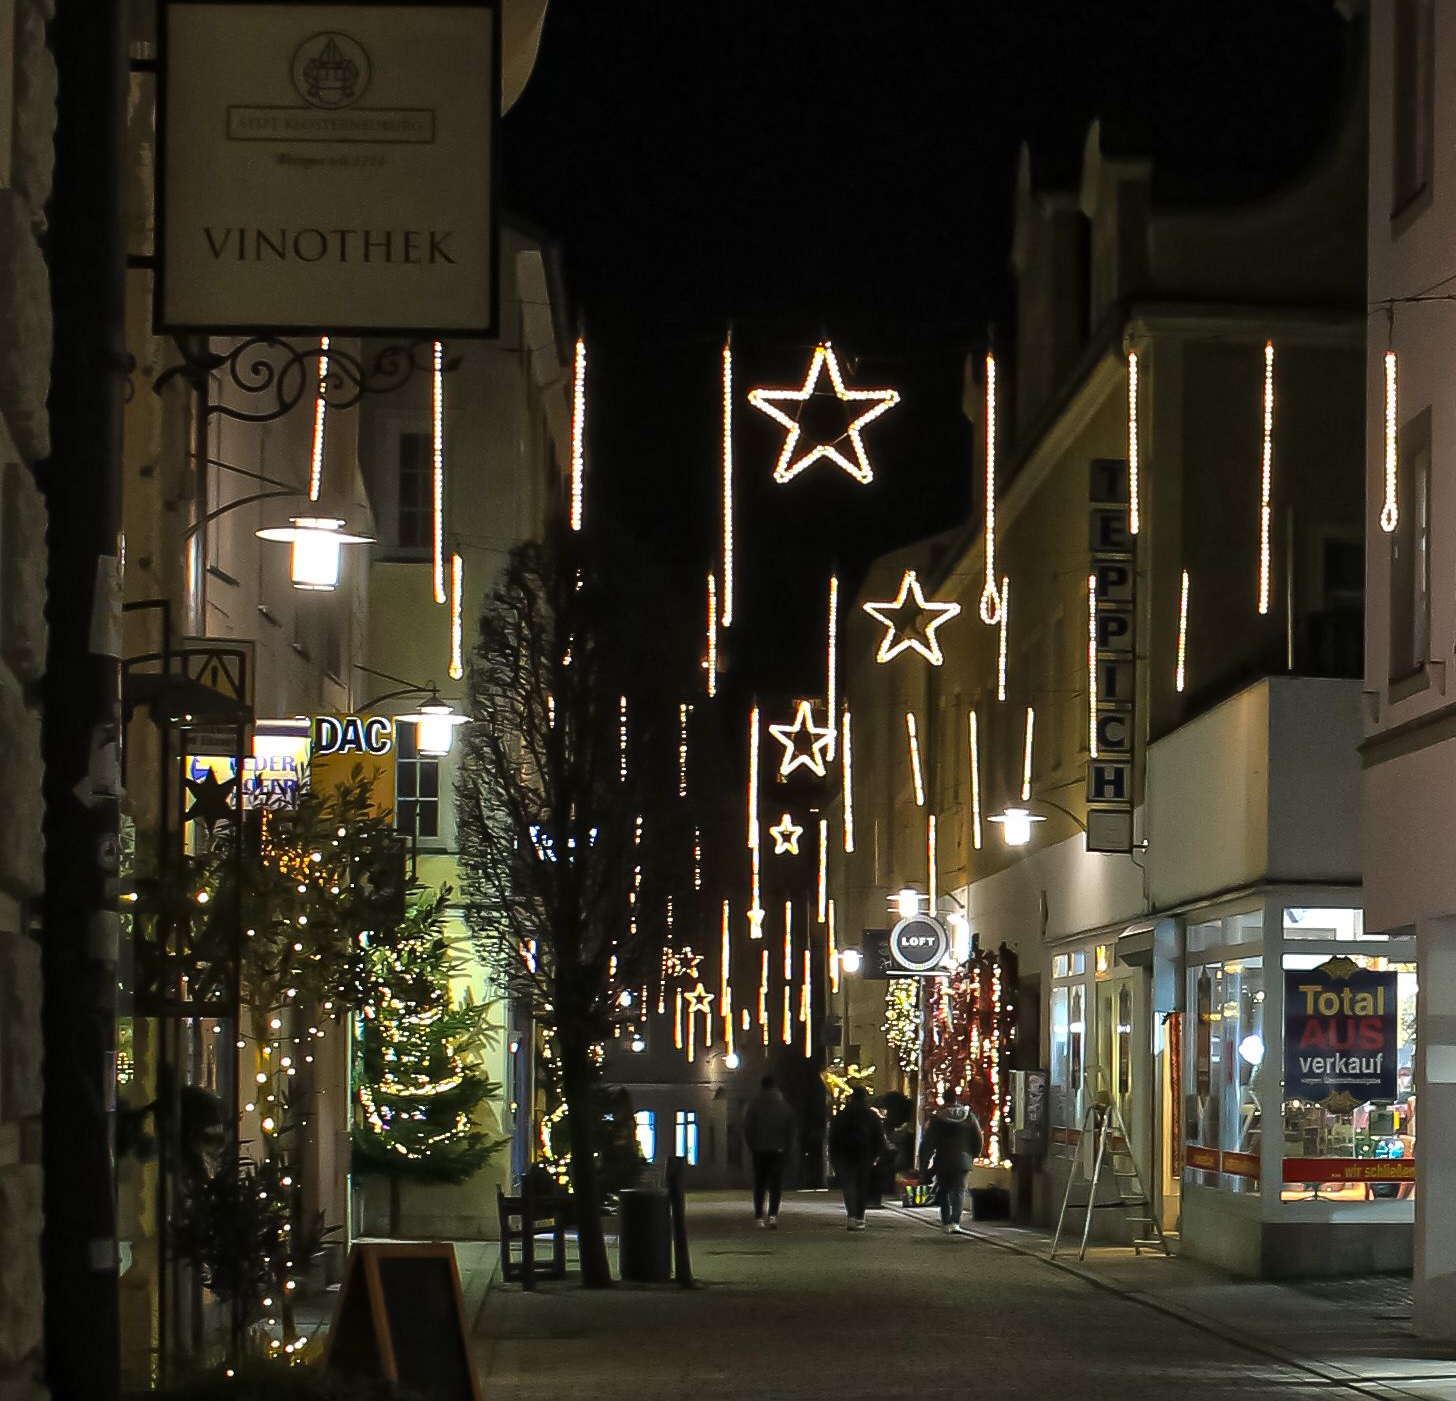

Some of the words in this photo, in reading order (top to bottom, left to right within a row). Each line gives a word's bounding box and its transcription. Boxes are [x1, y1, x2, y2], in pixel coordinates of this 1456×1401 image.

[204, 228, 456, 264] VINOTHEK
[1092, 464, 1129, 799] TEPPICH
[315, 716, 392, 755] DAC
[901, 936, 936, 946] LOFT
[1298, 985, 1385, 1016] Total
[1298, 1017, 1385, 1050] AUS
[1299, 1052, 1384, 1074] verkauf
[1344, 1164, 1361, 1178] wir
